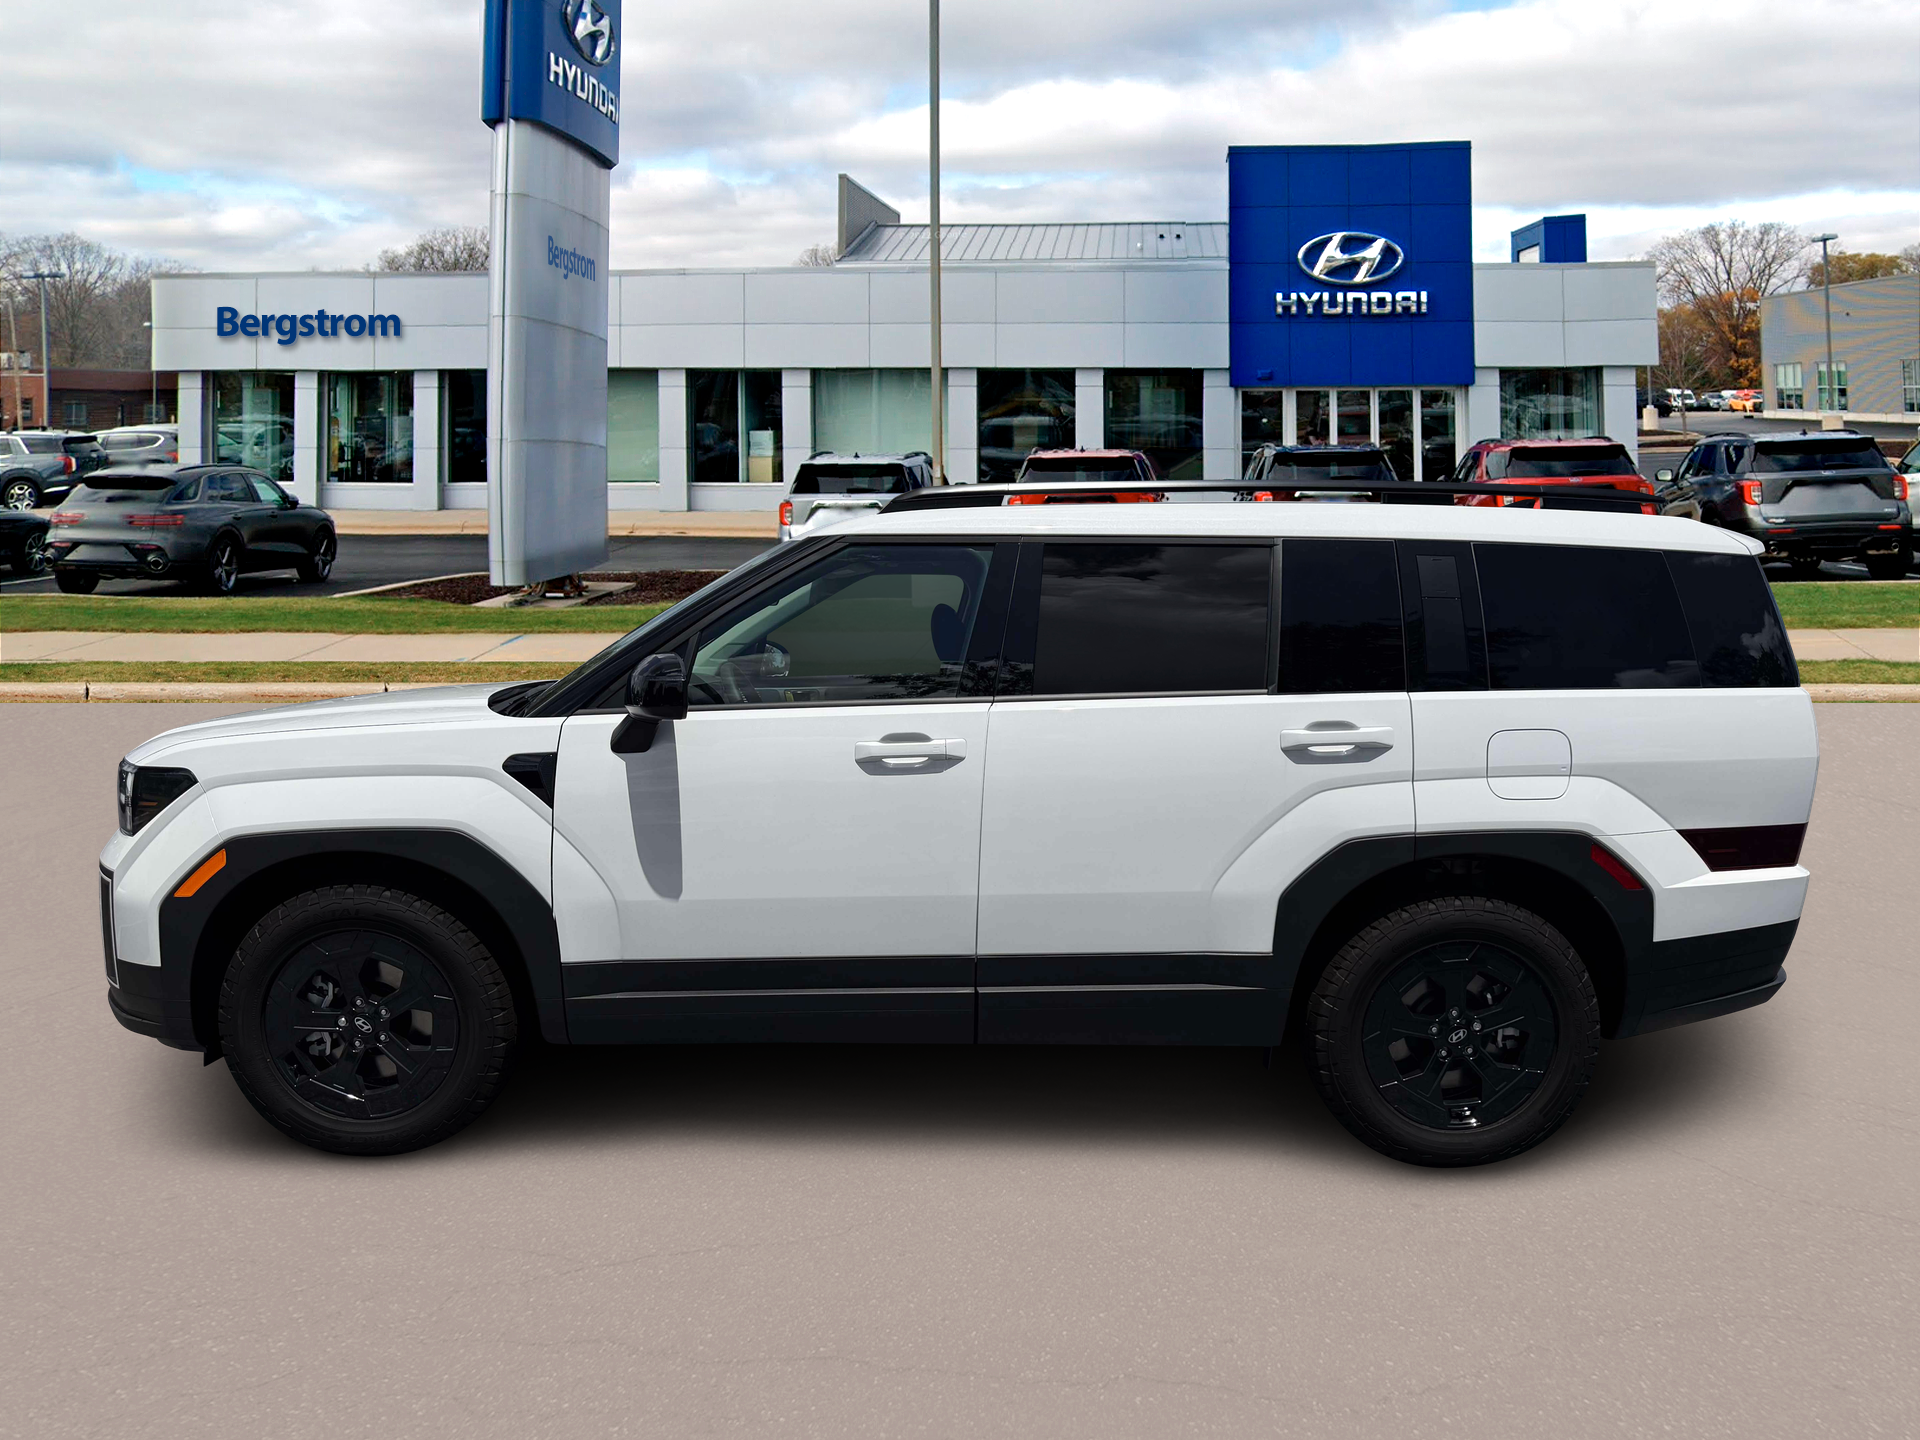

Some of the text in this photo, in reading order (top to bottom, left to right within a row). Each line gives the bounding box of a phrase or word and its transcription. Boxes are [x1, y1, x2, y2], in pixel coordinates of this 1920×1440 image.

[549, 51, 619, 124] HYUNDAI
[547, 235, 596, 282] Bergstrom
[1275, 291, 1428, 315] HYUNDAI
[216, 306, 401, 346] Bergstrom
